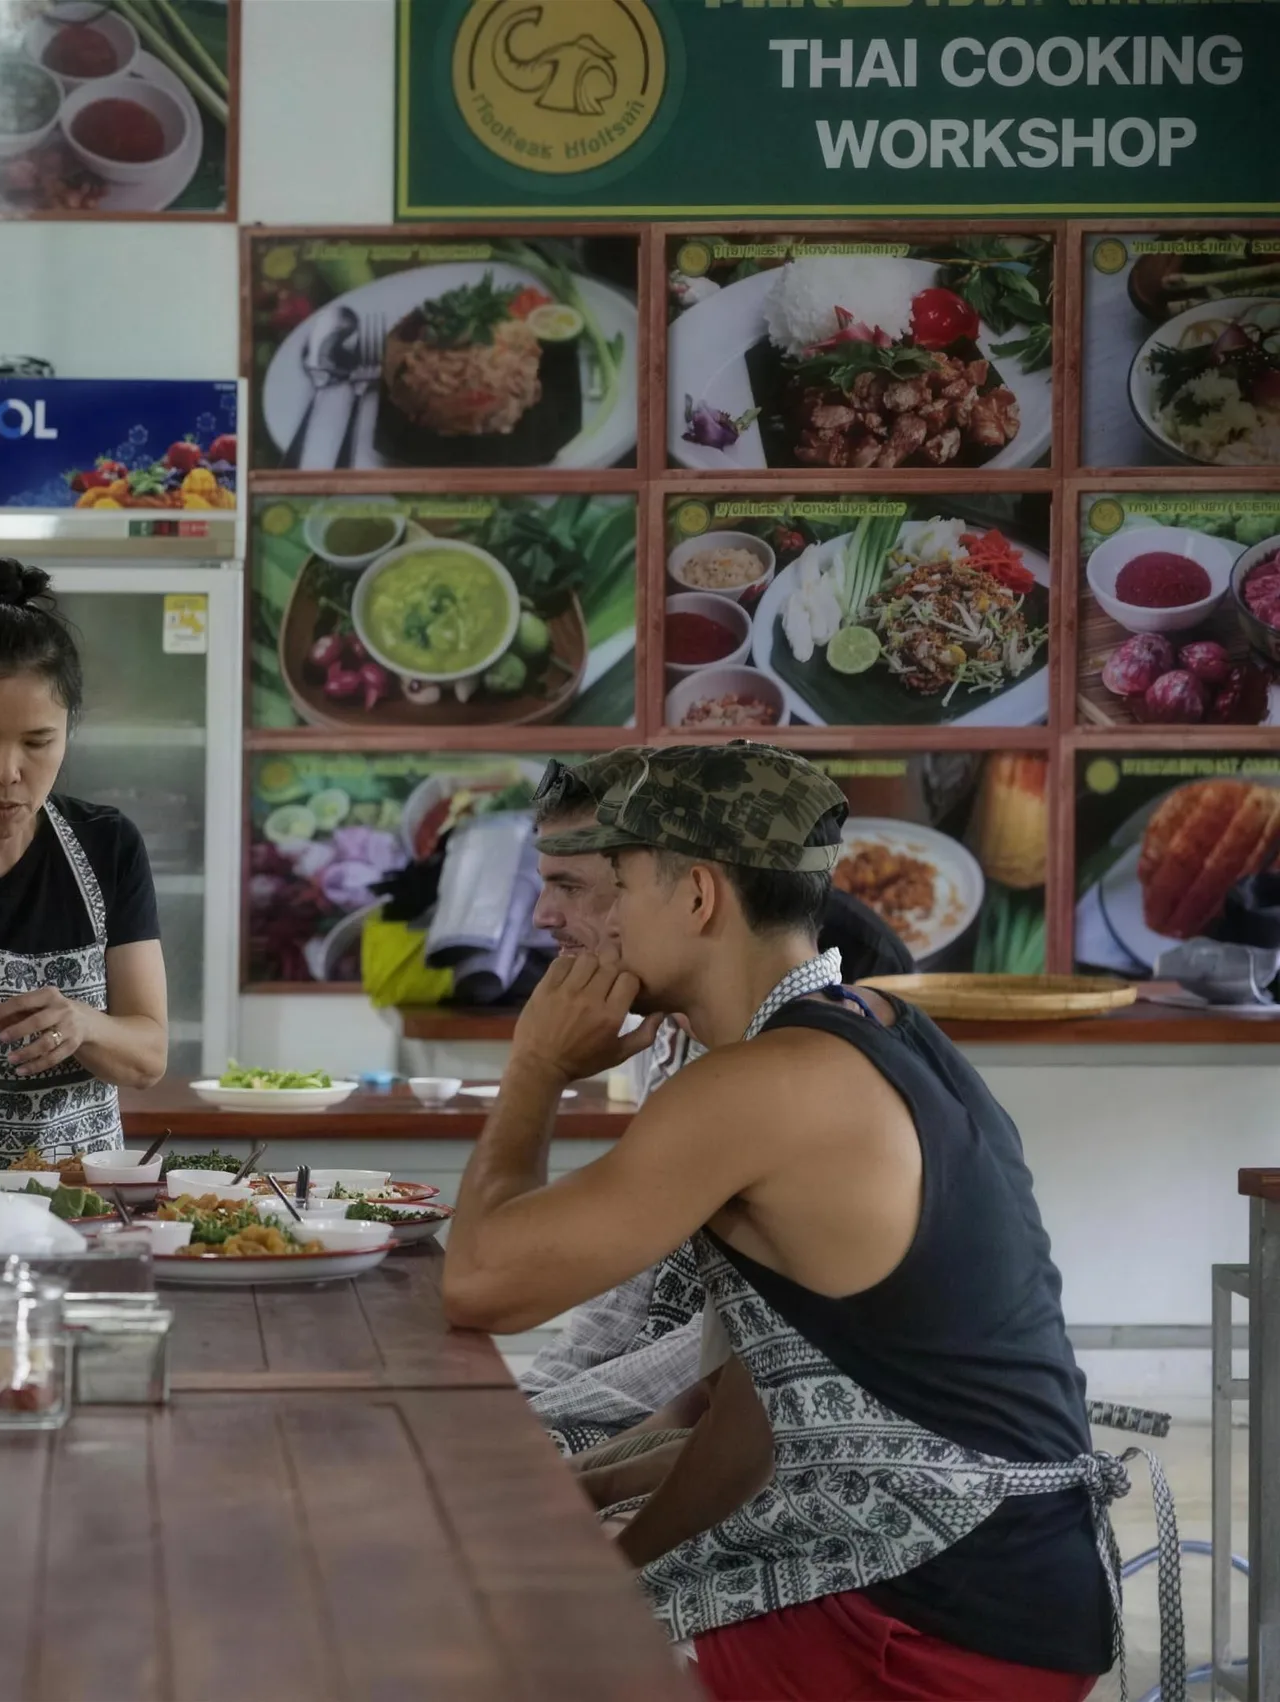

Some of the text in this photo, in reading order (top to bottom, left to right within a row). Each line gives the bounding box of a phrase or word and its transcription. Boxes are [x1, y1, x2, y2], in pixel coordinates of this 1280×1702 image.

[769, 36, 1243, 88] THAI COOKING
[815, 117, 1198, 169] WORKSHOP
